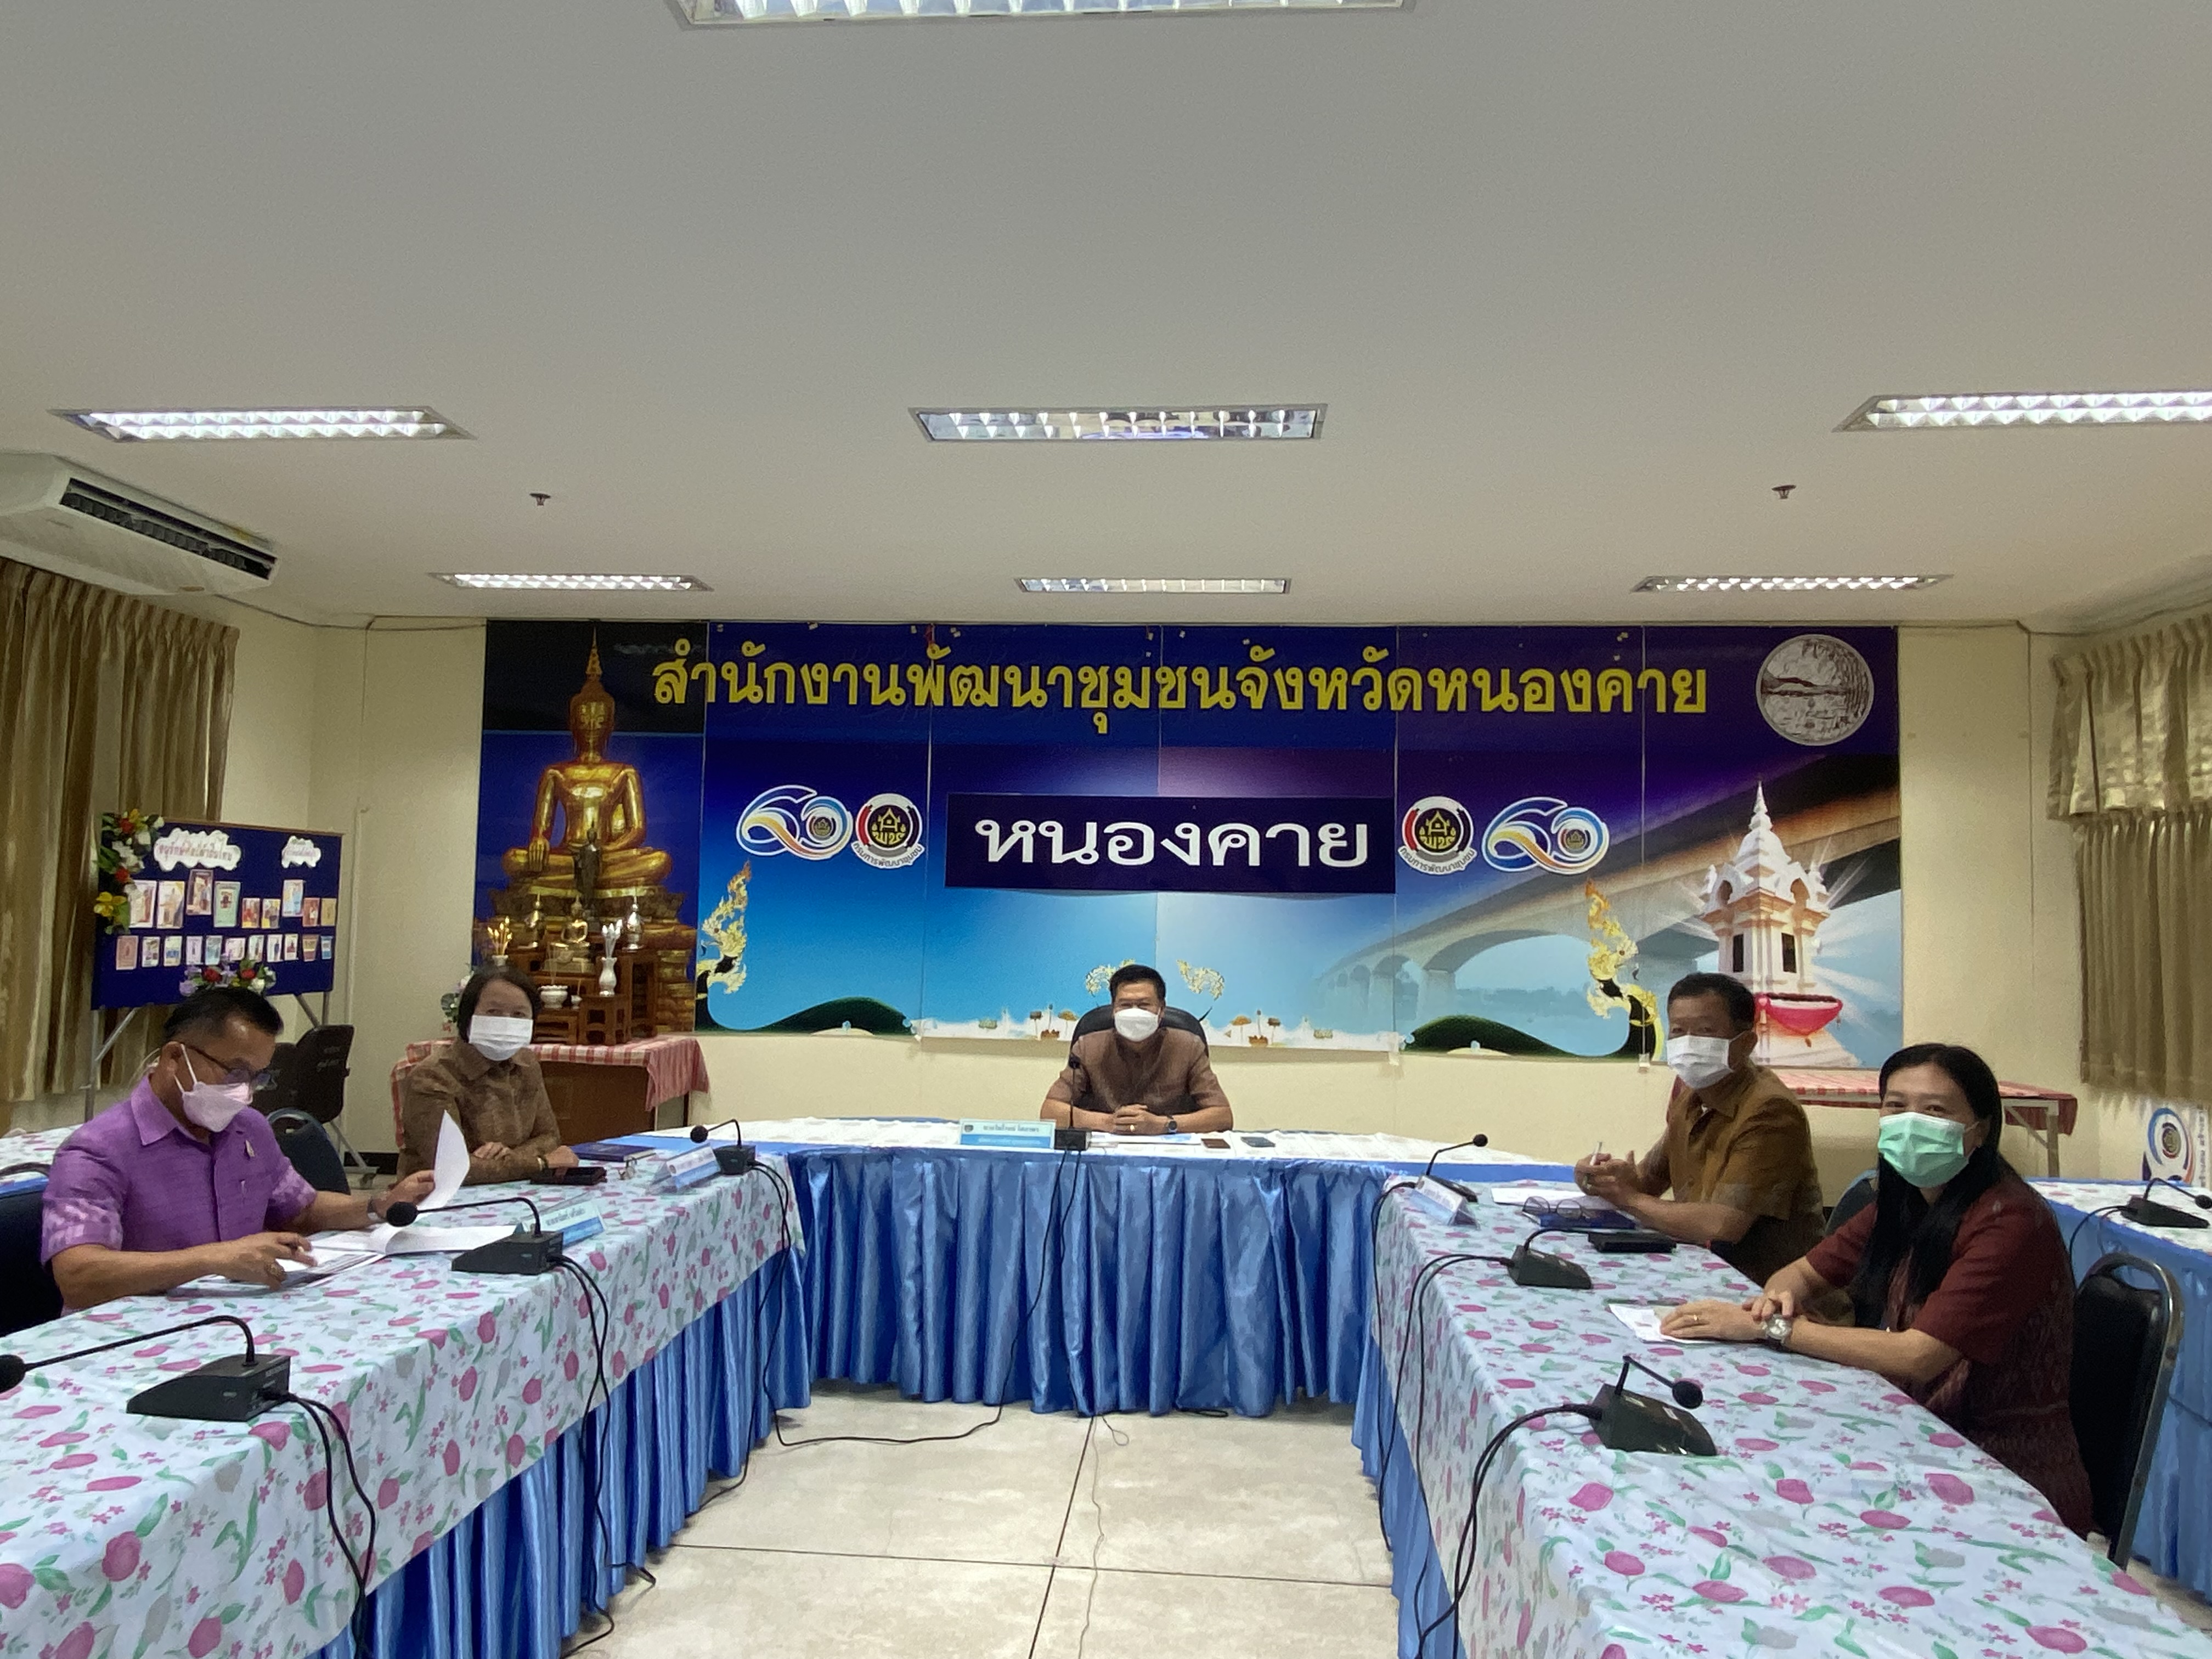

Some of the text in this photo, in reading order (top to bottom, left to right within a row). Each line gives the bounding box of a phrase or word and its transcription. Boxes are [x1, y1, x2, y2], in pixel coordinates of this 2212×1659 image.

[652, 637, 1707, 734] สำนักงานพัฒนาชุมชนจังหวัดหนองคาย
[974, 819, 1368, 867] หนองคาย
